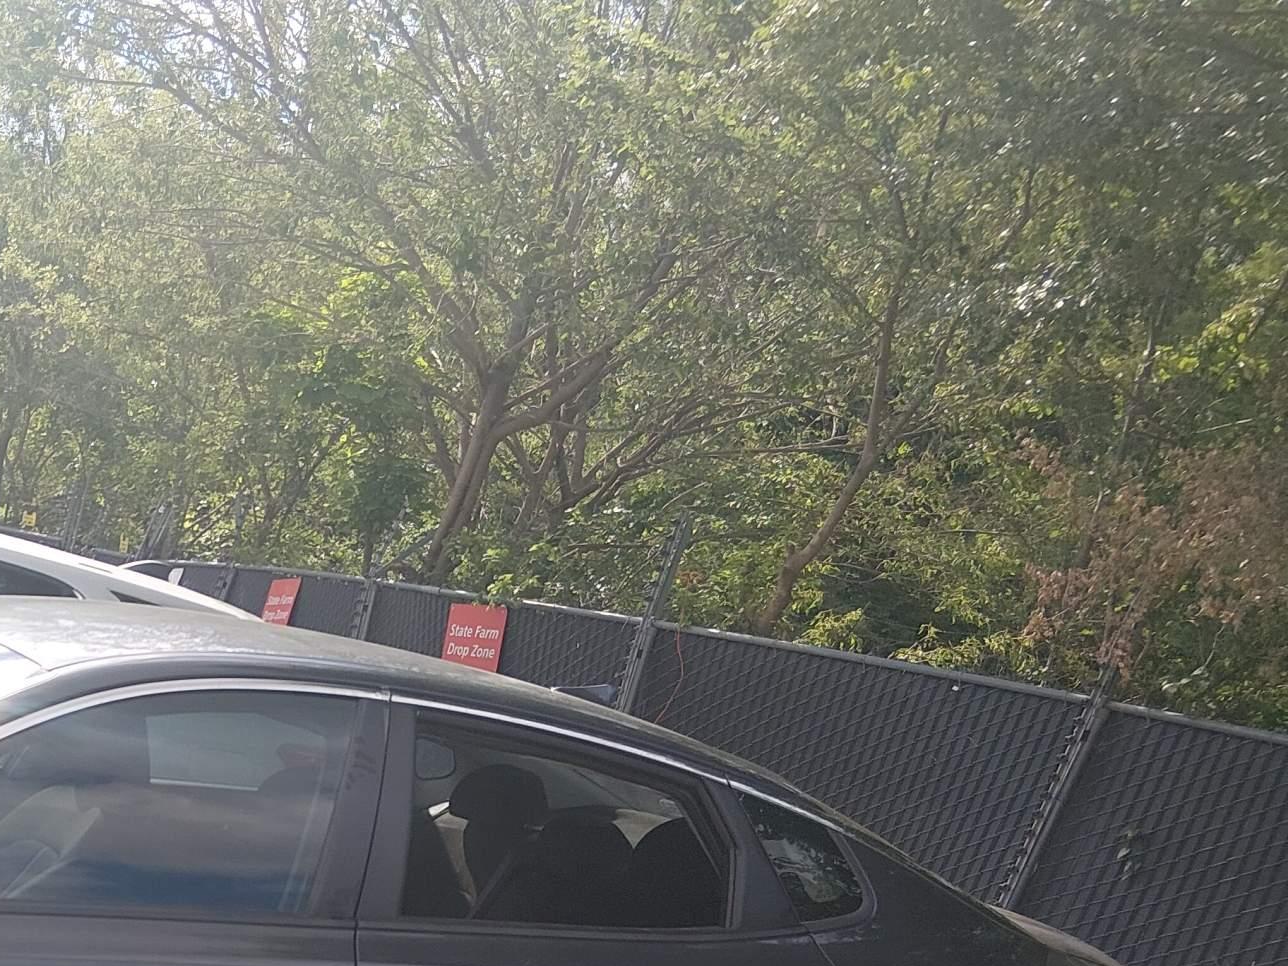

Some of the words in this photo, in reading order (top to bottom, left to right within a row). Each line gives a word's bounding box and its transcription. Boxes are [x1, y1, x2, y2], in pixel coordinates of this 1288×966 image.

[449, 624, 473, 638] State
[474, 625, 500, 640] Farm
[447, 642, 470, 660] Drop
[470, 644, 495, 659] Zone
